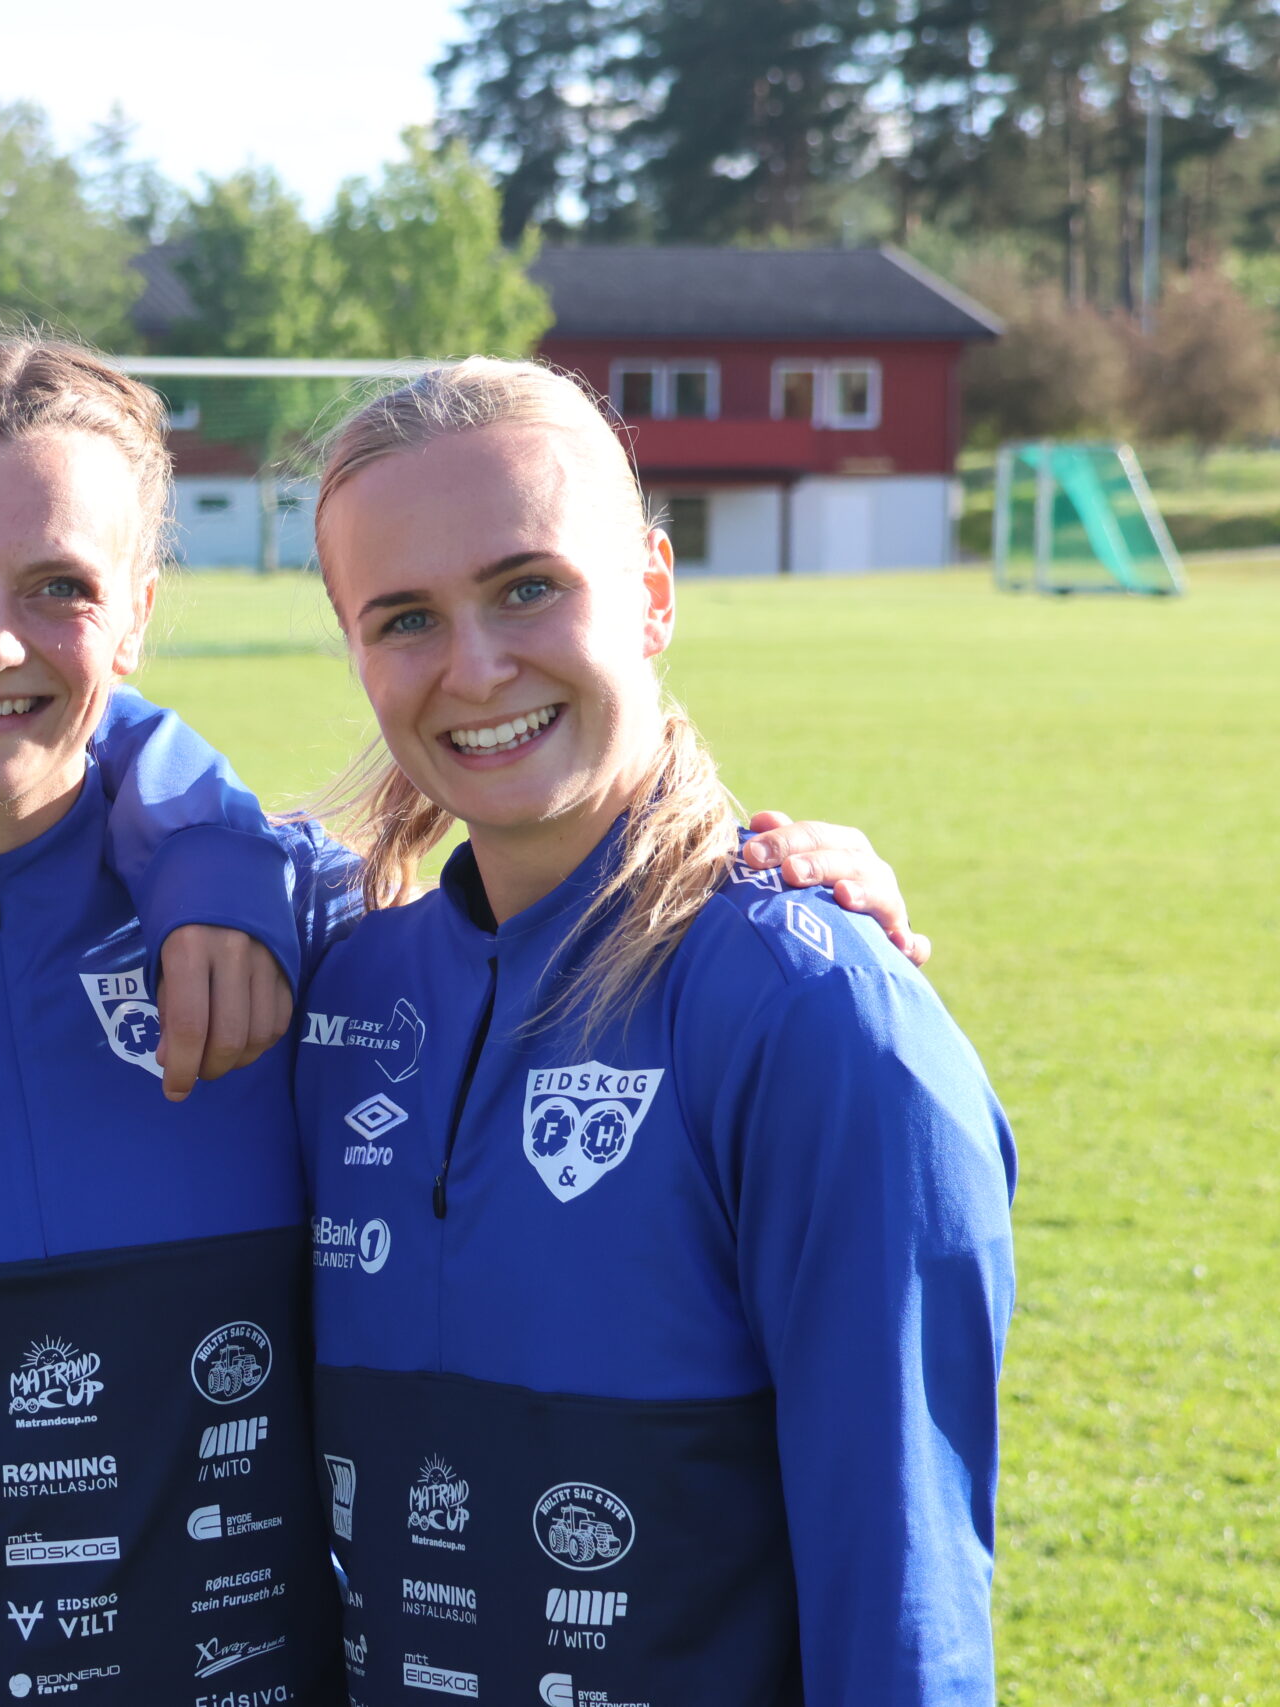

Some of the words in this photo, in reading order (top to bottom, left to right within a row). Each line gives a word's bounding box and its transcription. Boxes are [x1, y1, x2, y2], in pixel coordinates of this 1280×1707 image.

[533, 1072, 648, 1093] EIDSKOG
[543, 1122, 559, 1144] F
[595, 1125, 614, 1147] H
[344, 1141, 393, 1166] umbro
[558, 1166, 577, 1188] &
[197, 1330, 228, 1362] HOLTET
[230, 1326, 245, 1338] SAG
[251, 1330, 267, 1350] MYR
[10, 1352, 101, 1398] MATRAND
[39, 1380, 104, 1409] CUP
[15, 1414, 98, 1429] Matrandcup.no
[213, 1458, 251, 1480] WITO
[3, 1477, 118, 1499] INSTALLASJON
[409, 1480, 469, 1511] MATRAND
[539, 1489, 571, 1516] HOLTET
[574, 1488, 593, 1500] SAG
[604, 1498, 626, 1521] MYR
[226, 1512, 252, 1526] BYGDE
[227, 1516, 282, 1536] ELEKTRIKEREN
[428, 1505, 470, 1533] CUP
[8, 1532, 43, 1544] mitt
[411, 1534, 466, 1551] Matrandcup.no
[9, 1542, 117, 1561] EIDSKOG
[205, 1568, 272, 1592] RØRLEGGER
[57, 1593, 118, 1611] EIDSKOG
[191, 1597, 220, 1614] Stein
[222, 1587, 270, 1608] Furuseth
[272, 1583, 285, 1597] AS
[402, 1578, 477, 1610] RØNNING
[58, 1609, 118, 1639] VILT
[402, 1602, 477, 1625] INSTALLASJON
[563, 1630, 606, 1650] WITO
[404, 1653, 429, 1666] mitt
[37, 1664, 120, 1687] BONNERUD
[406, 1669, 478, 1693] EIDSKOG
[37, 1682, 78, 1696] farve
[578, 1690, 608, 1702] BYGDE
